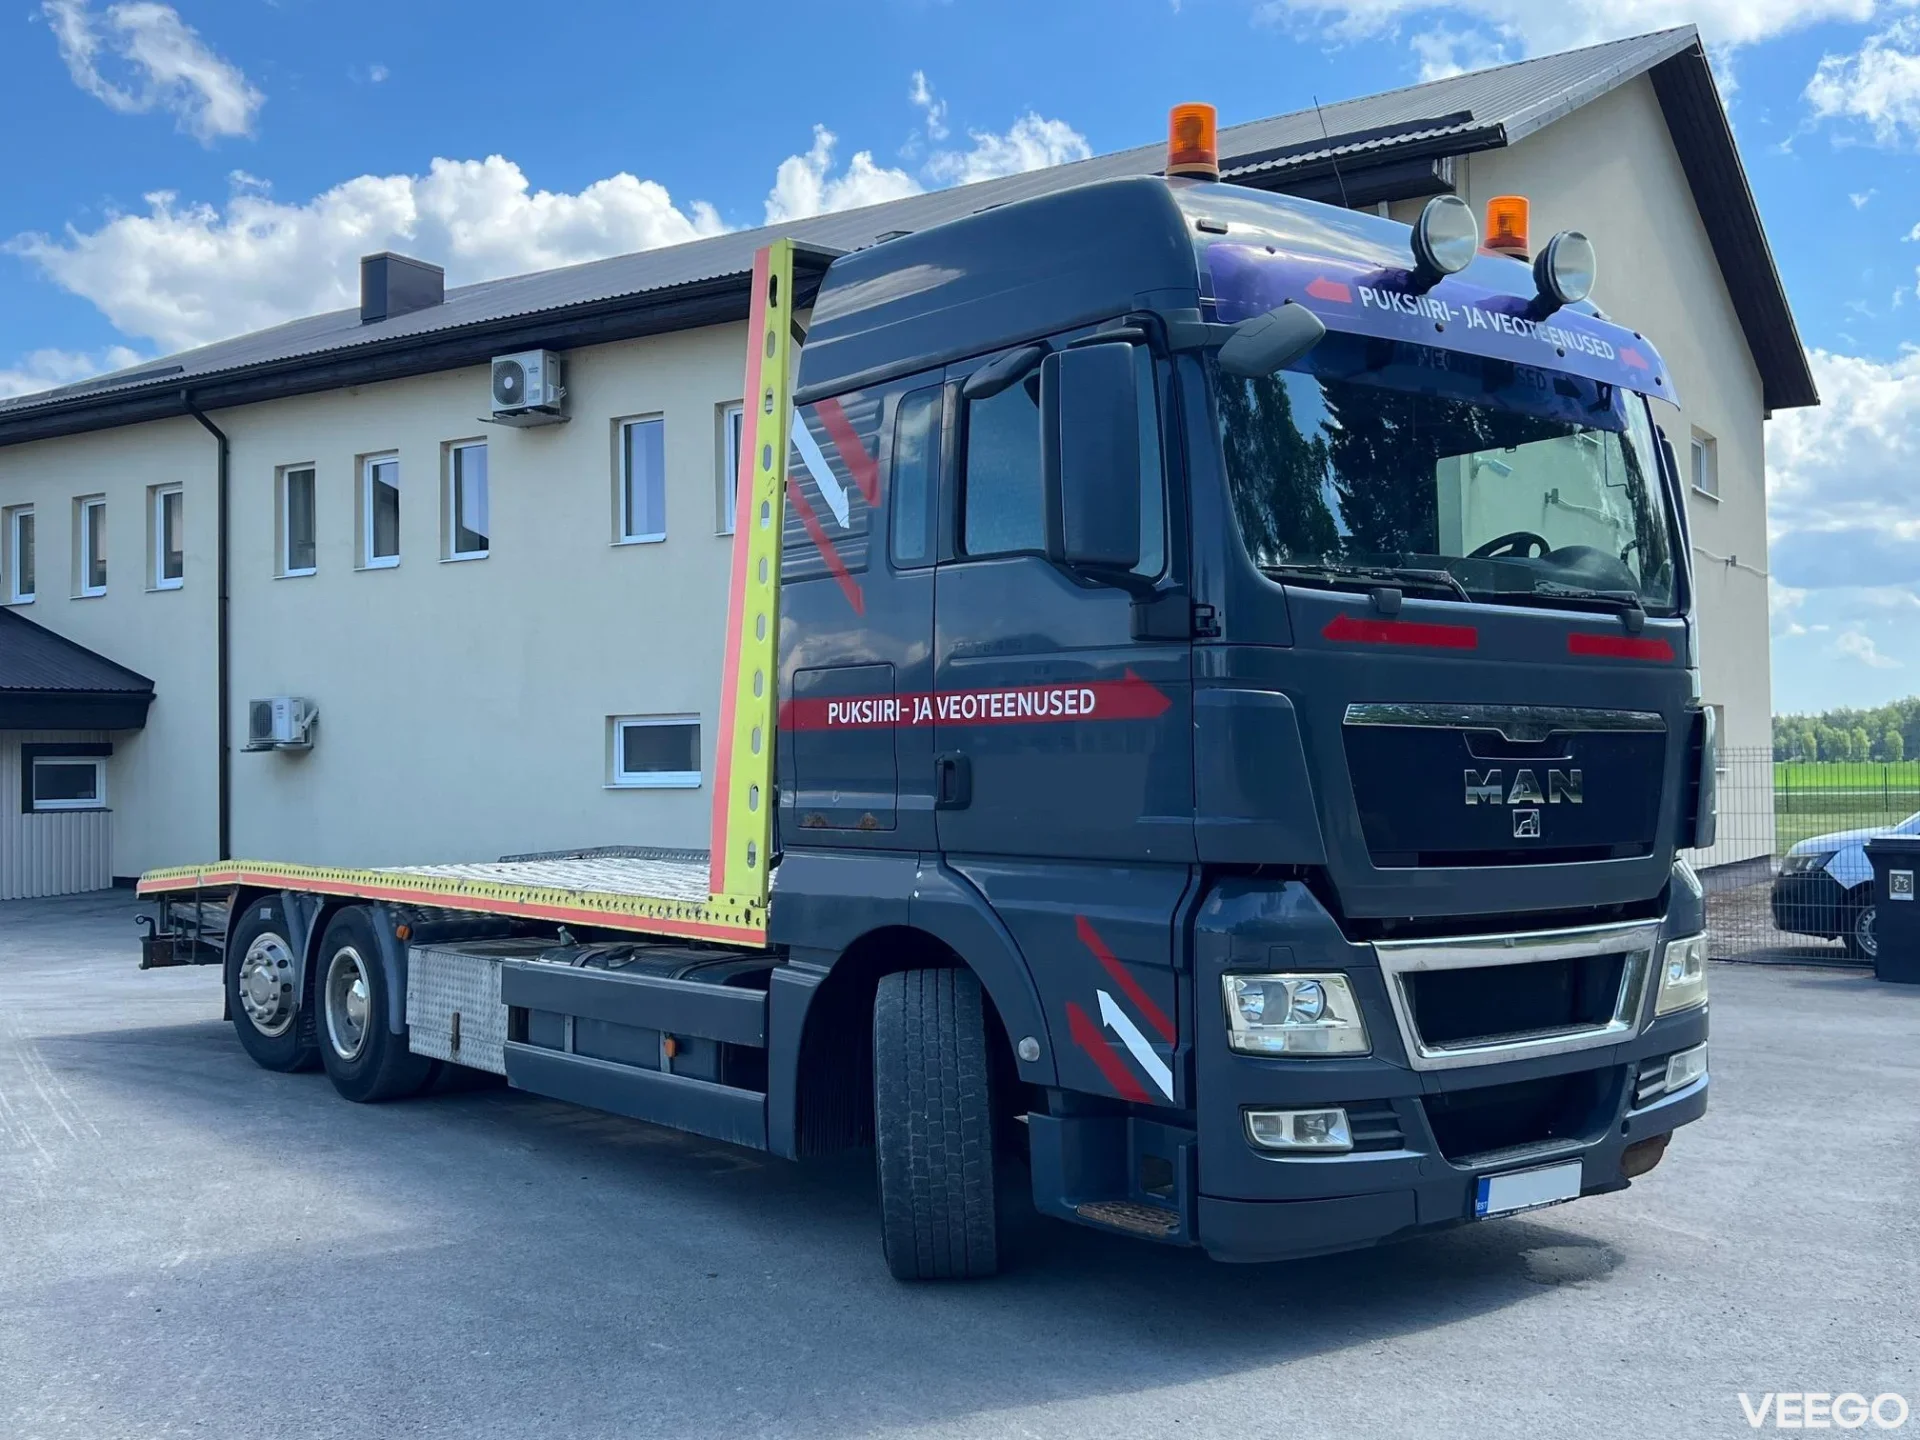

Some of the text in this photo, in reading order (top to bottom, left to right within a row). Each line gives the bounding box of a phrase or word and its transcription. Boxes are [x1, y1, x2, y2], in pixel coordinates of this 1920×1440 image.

[1358, 285, 1616, 360] PUKSIIRI- JA VEOTEENUSED
[828, 688, 1096, 725] PUKSIIRI- JA VEOTEENUSED
[1464, 769, 1583, 804] MAN
[1477, 1201, 1488, 1210] EST
